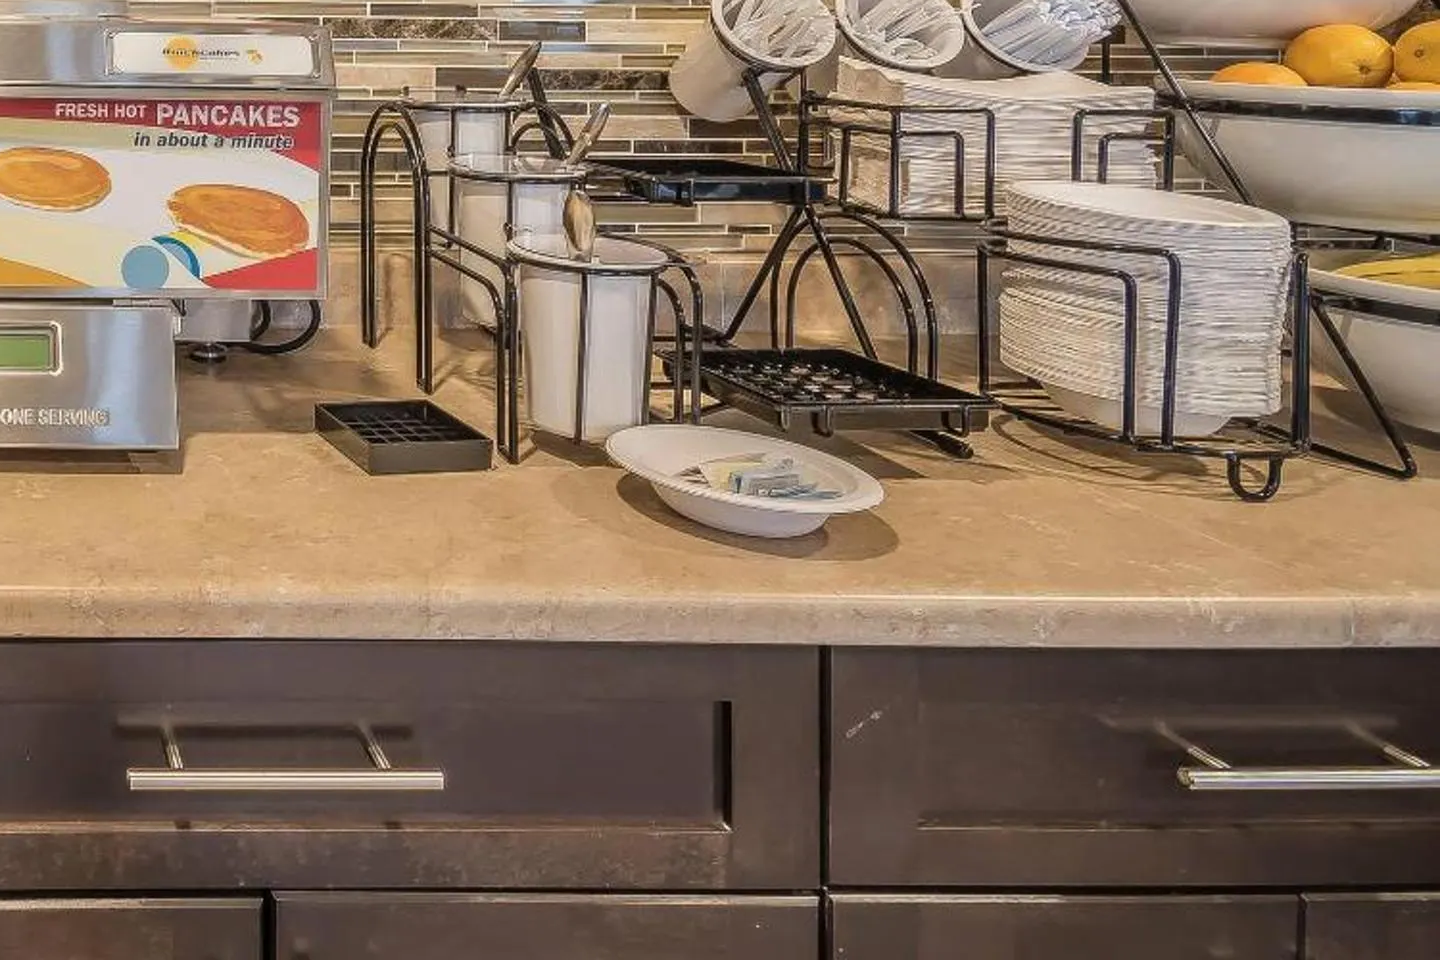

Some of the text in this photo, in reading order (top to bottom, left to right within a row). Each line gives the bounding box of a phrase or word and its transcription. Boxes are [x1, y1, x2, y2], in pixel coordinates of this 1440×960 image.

[55, 102, 301, 128] FRESH HOT PANCAKES
[134, 132, 295, 150] in about a minute
[0, 407, 34, 426] ONE
[38, 407, 108, 427] SERVING
